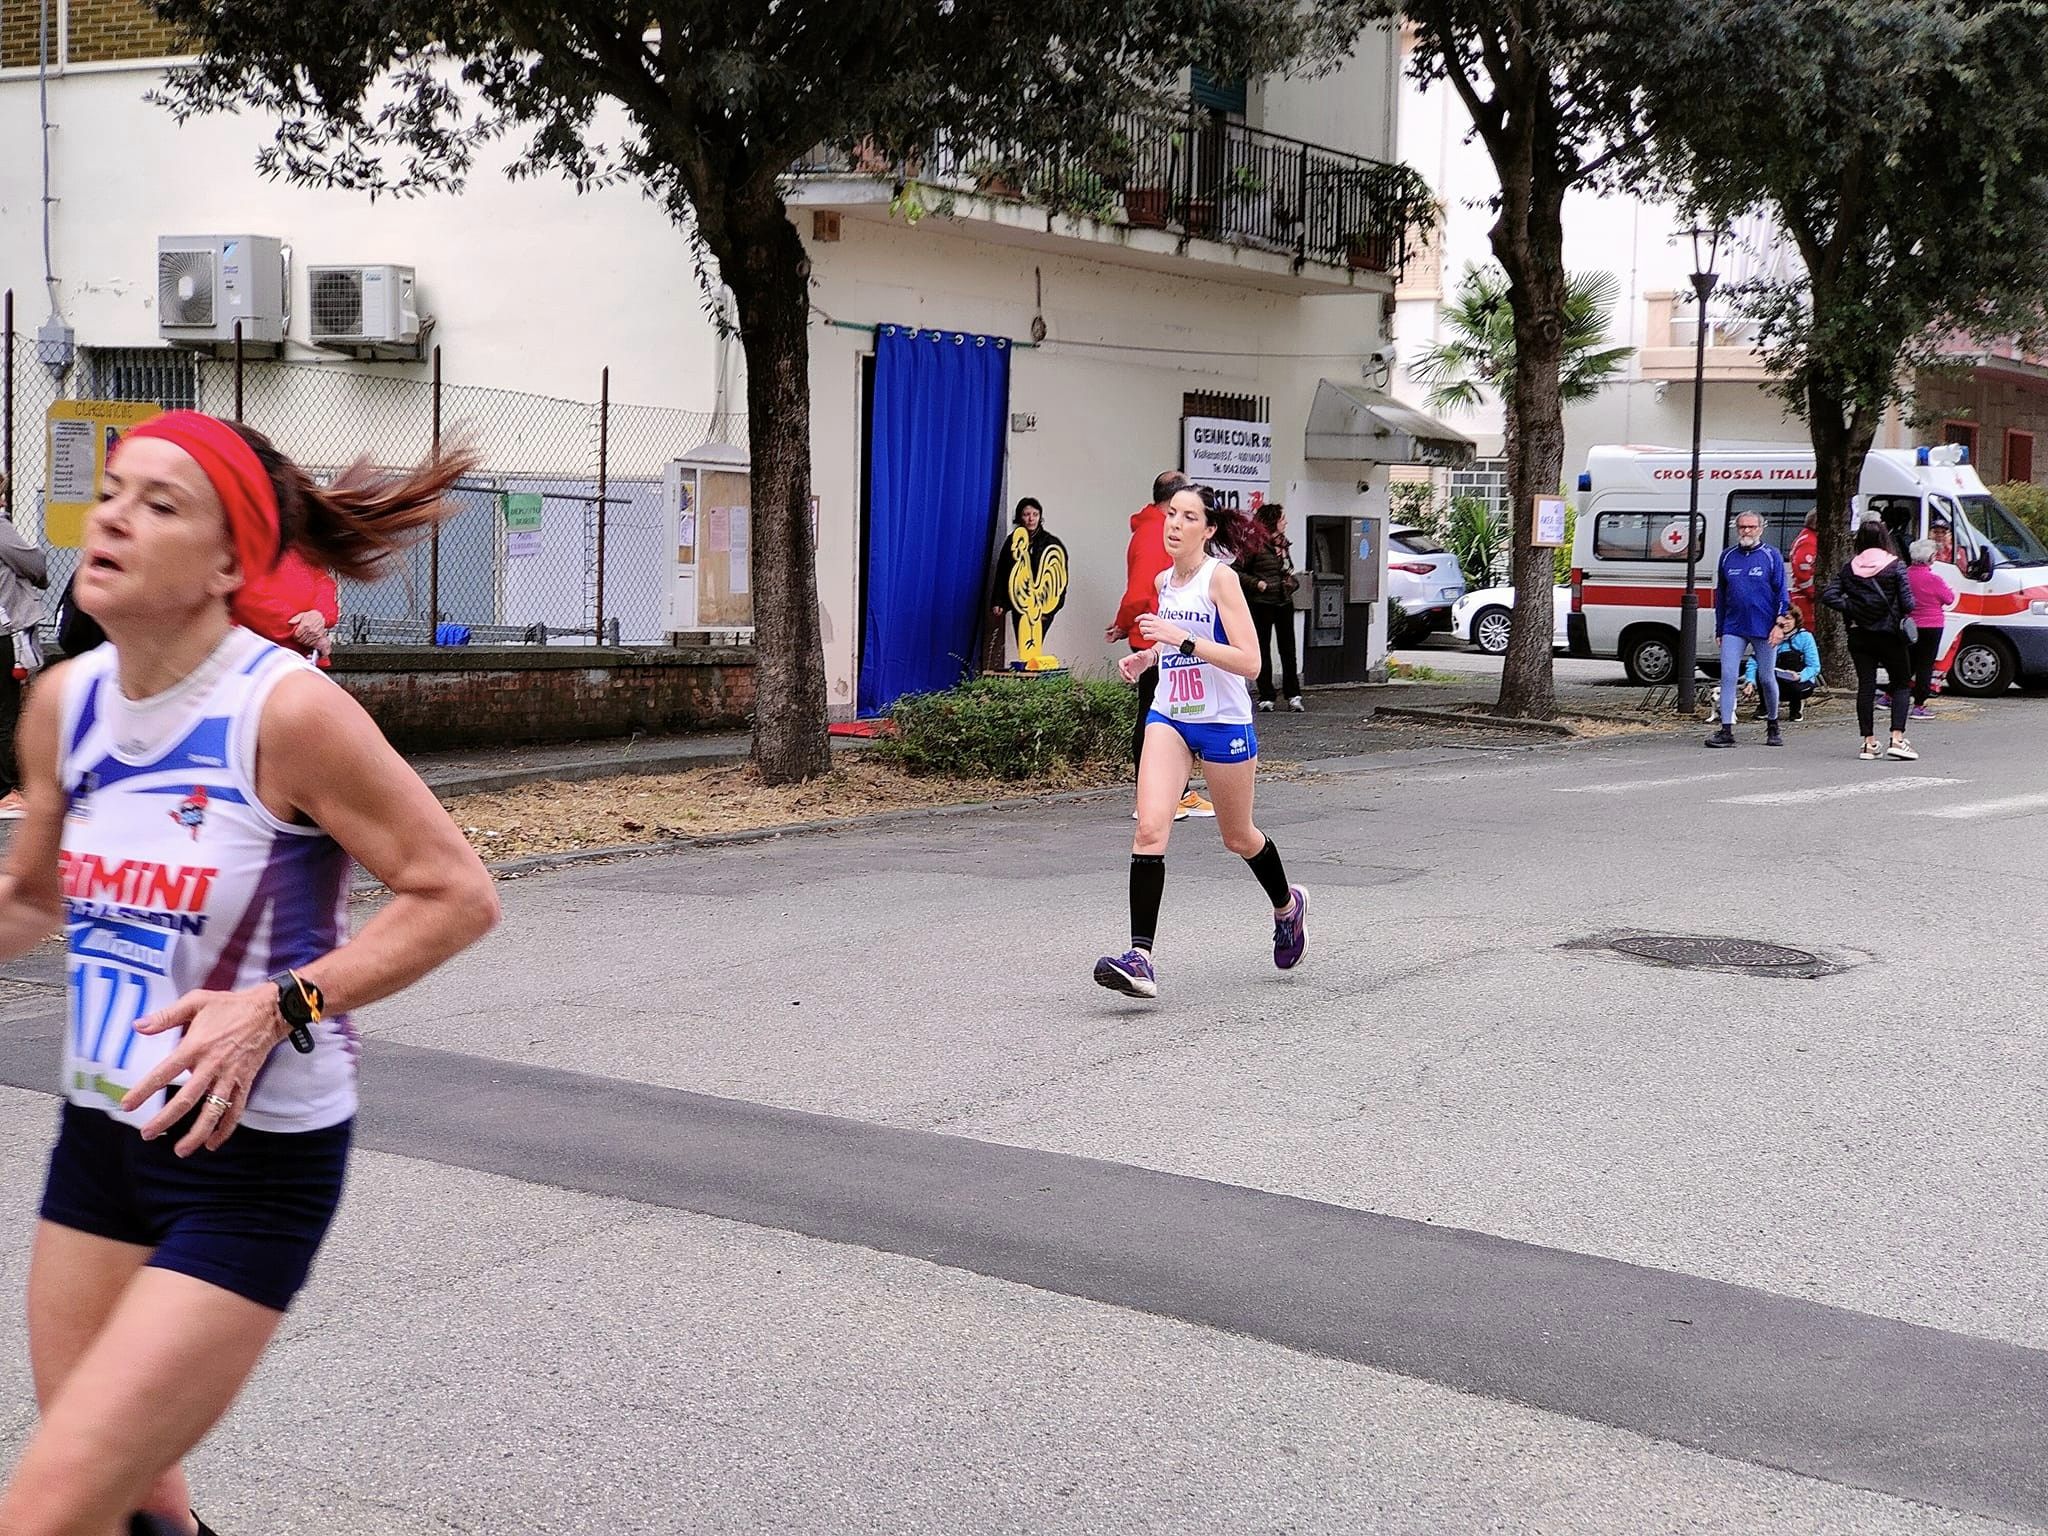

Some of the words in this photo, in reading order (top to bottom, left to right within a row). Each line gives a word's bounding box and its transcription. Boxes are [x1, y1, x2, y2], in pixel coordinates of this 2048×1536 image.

[1711, 469, 1764, 480] ROSSA
[1169, 667, 1205, 702] 206
[69, 962, 147, 1070] 177
